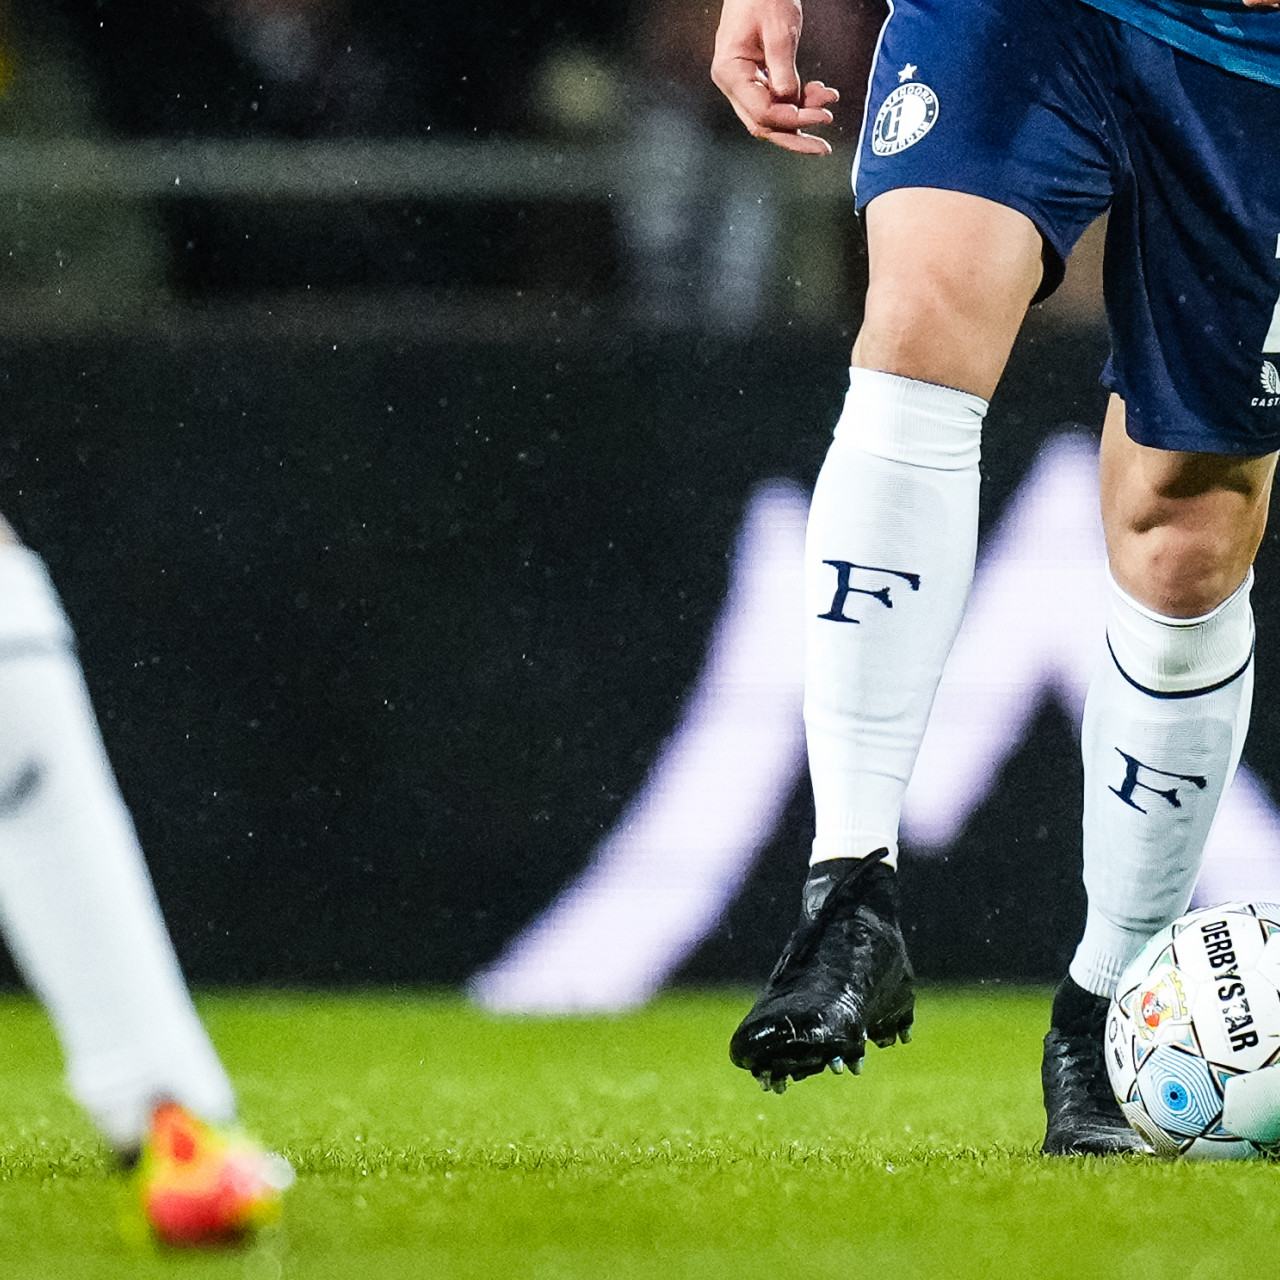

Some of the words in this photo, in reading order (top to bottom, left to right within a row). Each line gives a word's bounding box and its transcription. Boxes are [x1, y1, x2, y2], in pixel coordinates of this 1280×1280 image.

[817, 560, 920, 624] F
[1108, 747, 1207, 814] F
[1200, 920, 1260, 1053] DERBYSTAR
